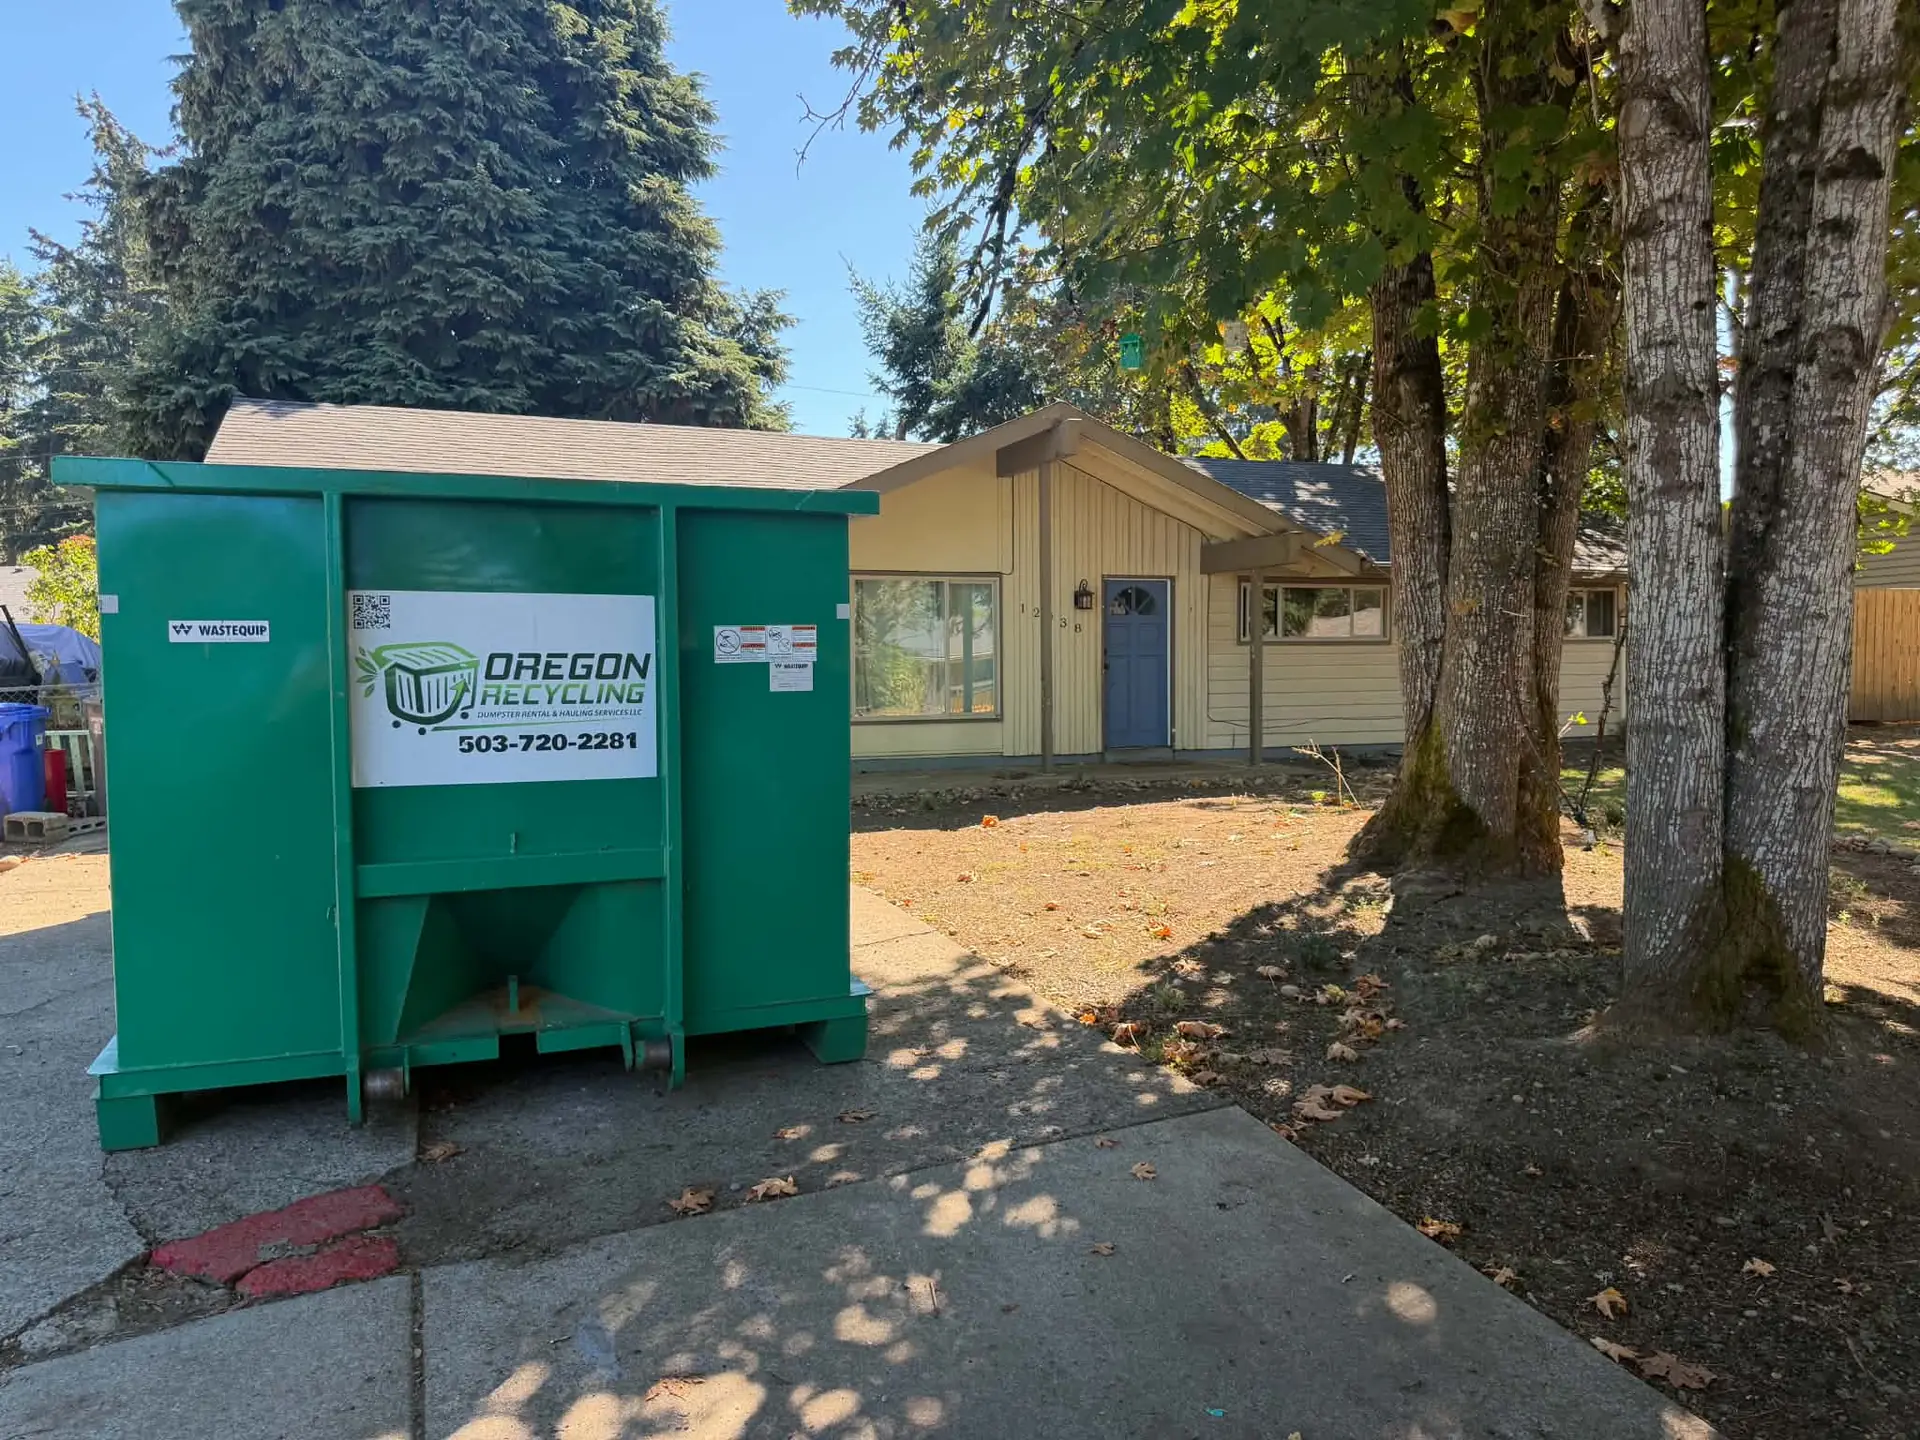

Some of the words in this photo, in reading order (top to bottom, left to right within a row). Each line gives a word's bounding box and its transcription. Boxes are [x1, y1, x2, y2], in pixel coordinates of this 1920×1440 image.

[198, 624, 267, 637] WASTEQUIP
[484, 652, 652, 681] OREGON
[480, 683, 646, 705] RECYCLING
[477, 710, 520, 719] DUMPSTER
[521, 710, 550, 718] RENTAL
[552, 709, 558, 717] &
[559, 709, 594, 717] HAULING
[594, 709, 628, 717] SERVICES
[629, 708, 643, 716] LLC
[459, 732, 638, 753] 503-720-2281
